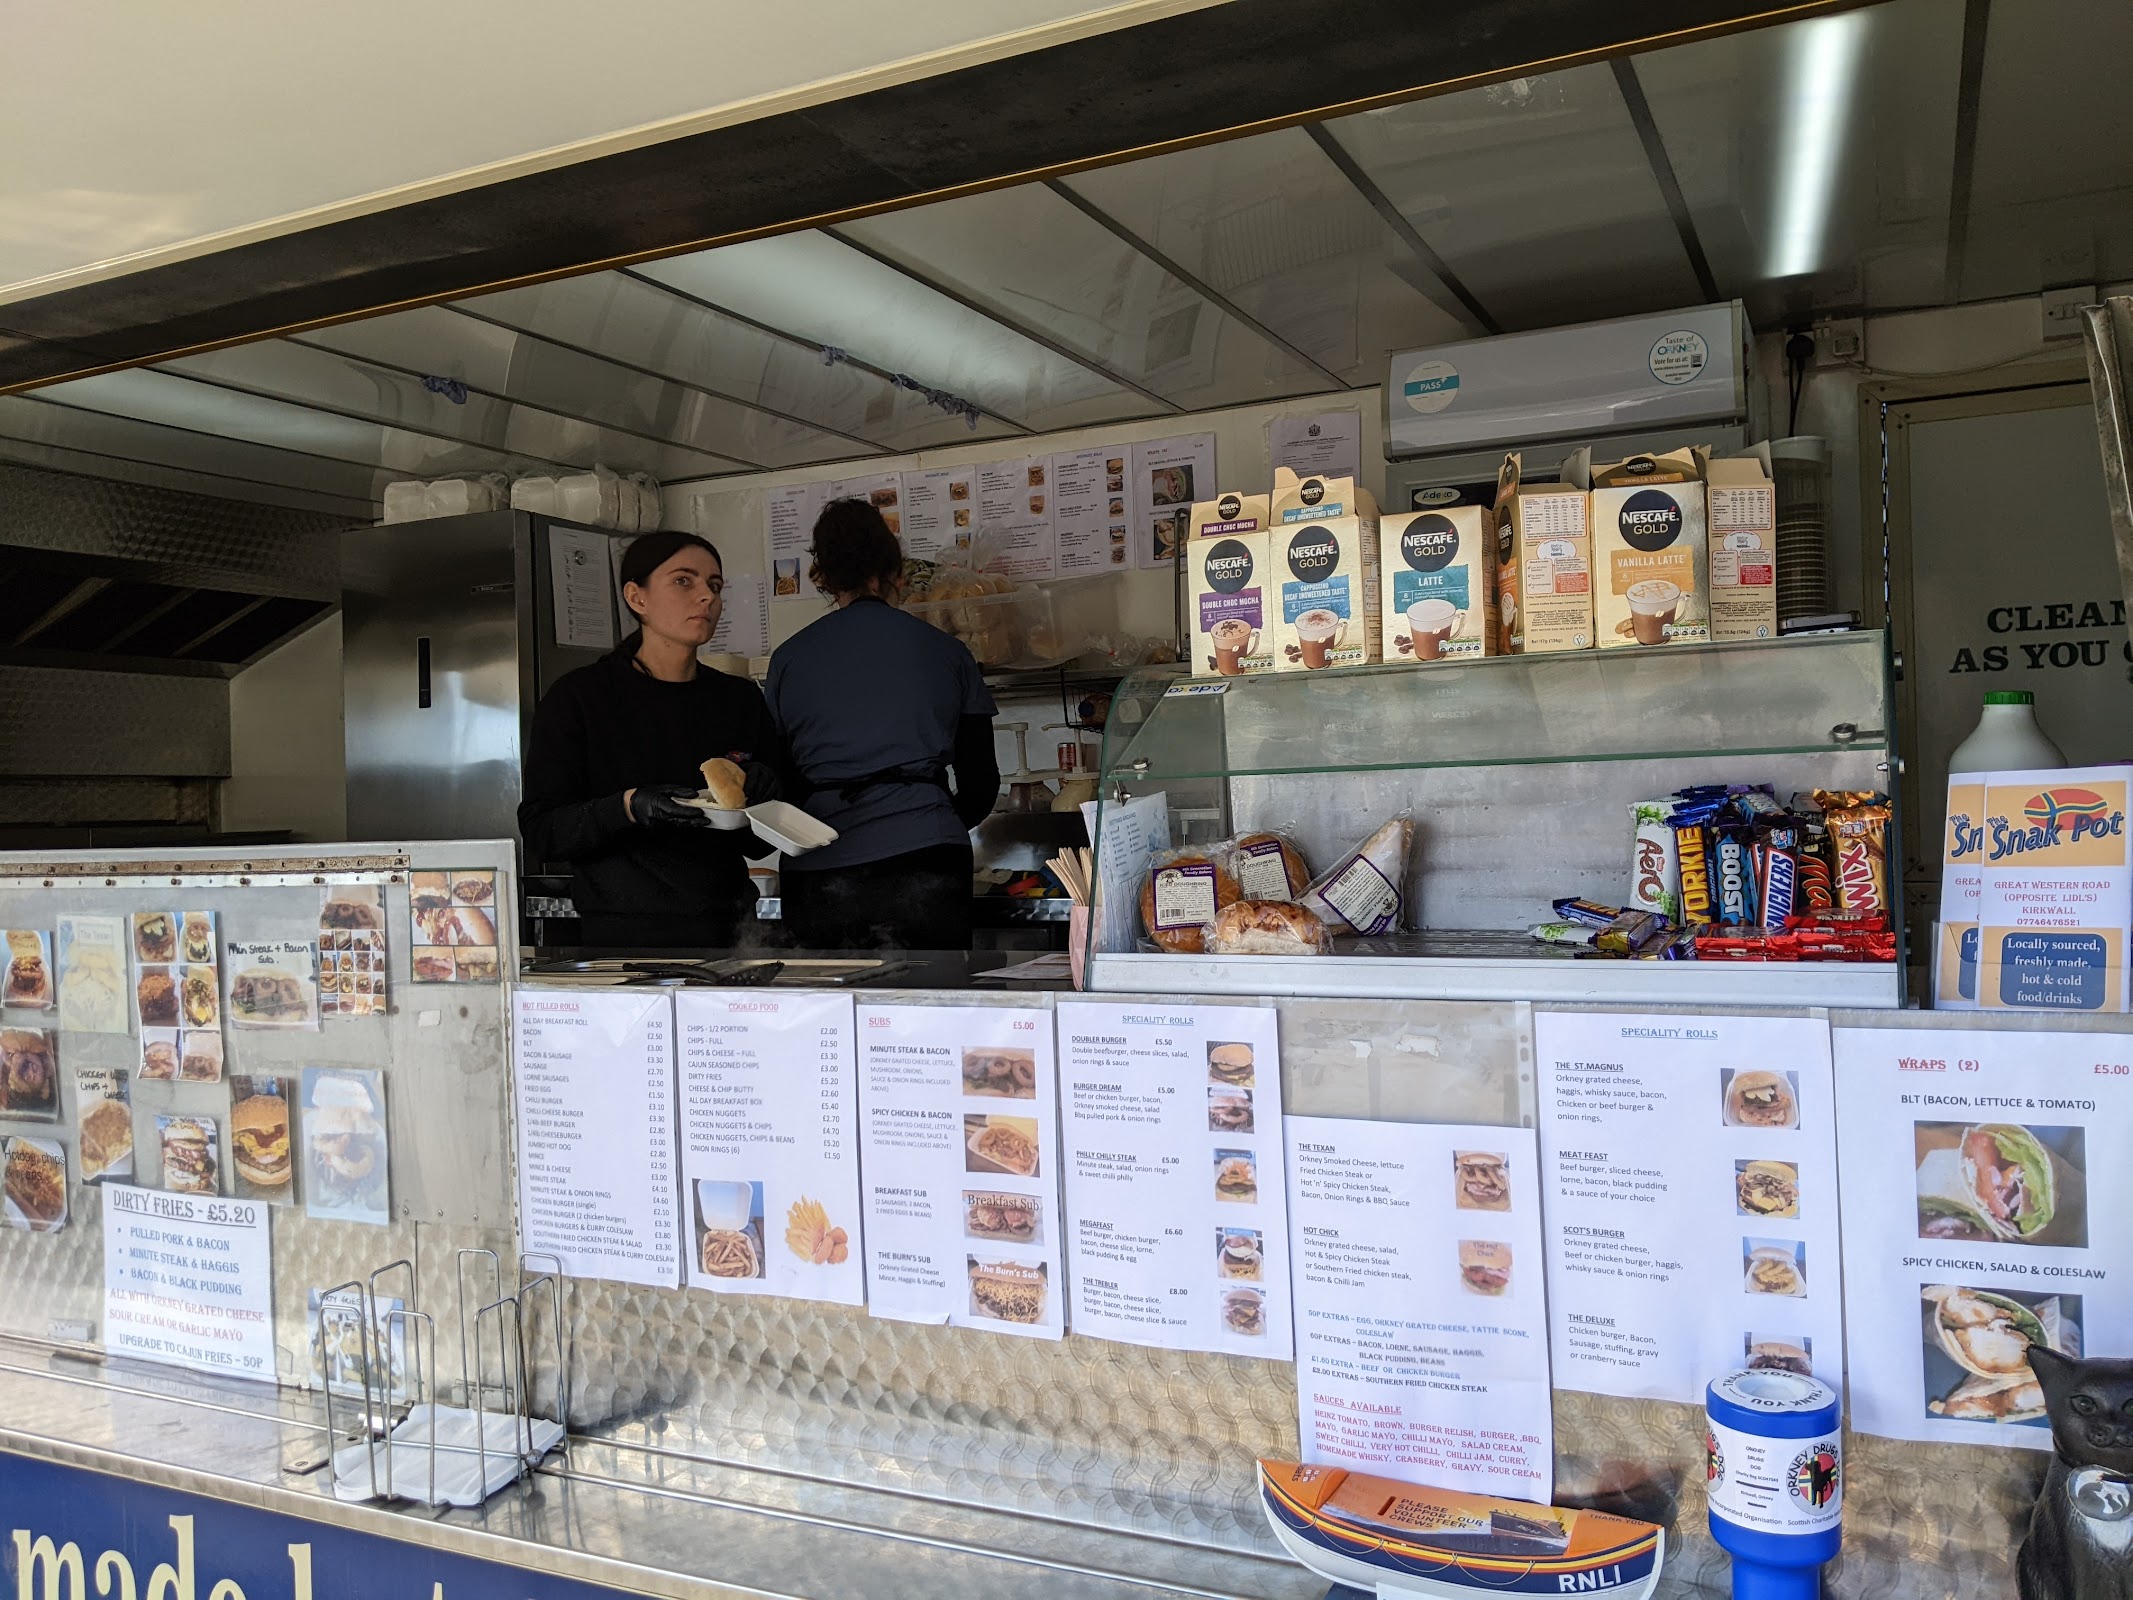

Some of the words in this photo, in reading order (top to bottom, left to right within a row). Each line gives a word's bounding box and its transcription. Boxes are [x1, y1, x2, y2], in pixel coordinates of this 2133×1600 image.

[1657, 342, 1699, 355] ORKNEY
[1420, 380, 1441, 391] PASS
[1203, 524, 1222, 534] DOUBLE
[1223, 523, 1236, 532] CHOC
[1237, 521, 1255, 530] MOCHA
[1633, 523, 1668, 535] GOLD
[1414, 546, 1446, 557] GOLD
[1299, 557, 1329, 568] GOLD
[1617, 556, 1654, 567] VANILLA
[1215, 569, 1242, 579] GOLD
[1300, 582, 1329, 591] CAPPUCCINO
[1418, 576, 1443, 586] LATTE
[1284, 591, 1298, 600] DECAF
[1299, 589, 1329, 600] UNSWEETENED
[1202, 599, 1222, 609] DOUBLE
[1223, 598, 1237, 608] CHOC
[1238, 597, 1259, 607] MOCHA
[1949, 646, 2009, 673] AS
[2020, 640, 2110, 669] YOU
[1987, 814, 2007, 827] The
[1989, 818, 2060, 859] Snak
[2072, 811, 2124, 842] Pot
[1678, 826, 1712, 925] YORKIE
[1721, 843, 1744, 918] BOOST
[1994, 880, 2029, 889] GREAT
[2032, 880, 2081, 889] WESTERN
[2084, 881, 2110, 889] ROAD
[2004, 893, 2057, 902] (OPPOSITE
[2063, 893, 2098, 902] LIDL'S)
[2022, 906, 2076, 915] KIRKWALL
[2017, 918, 2081, 926] 07746476521
[284, 942, 309, 953] Bacon
[2007, 937, 2049, 952] Locally
[2052, 939, 2100, 952] sourced,
[2015, 955, 2052, 970] freshly
[2057, 957, 2091, 969] made,
[2022, 973, 2040, 985] hot
[2044, 975, 2054, 984] &
[2058, 974, 2082, 986] cold
[2017, 990, 2082, 1004] food/drinks
[559, 1002, 580, 1011] ROLLS
[729, 1003, 755, 1012] COOKED
[757, 1003, 779, 1012] FOOD
[869, 1017, 891, 1026] SUBS
[1013, 1021, 1034, 1030] £5.00
[1122, 1015, 1166, 1025] SPECIALITY
[1170, 1017, 1194, 1025] ROLLS
[1621, 1027, 1681, 1038] SPECIALITY
[1686, 1029, 1718, 1038] ROLLS
[1072, 1035, 1098, 1044] DOUBLER
[1100, 1036, 1127, 1045] BURGER
[1155, 1038, 1172, 1046] £5.50
[870, 1046, 896, 1054] MINUTE
[927, 1048, 950, 1056] BACON
[1574, 1062, 1624, 1071] ST.MAGNUS
[1898, 1057, 1946, 1070] WRAPS
[1958, 1059, 1980, 1072] (2)
[2094, 1064, 2130, 1075] £5.00
[80, 1082, 101, 1091] CHIPS
[1901, 1095, 1920, 1104] BLT
[1923, 1095, 1971, 1107] (BACON,
[1975, 1097, 2022, 1107] LETTUCE
[2026, 1099, 2035, 1108] &
[2038, 1099, 2096, 1111] TOMATO)
[822, 1115, 839, 1123] £2.70
[1559, 1151, 1581, 1160] MEAT
[1584, 1152, 1608, 1161] FEAST
[113, 1190, 150, 1212] DIRTY
[154, 1195, 194, 1218] FRIES
[207, 1203, 255, 1224] £5.20
[968, 1194, 1018, 1210] Breakfast
[1020, 1198, 1040, 1211] Sub
[130, 1226, 160, 1242] PULLED
[162, 1231, 184, 1245] PORK
[187, 1236, 193, 1247] &
[197, 1237, 230, 1251] BACON
[129, 1247, 158, 1262] MINUTE
[161, 1252, 188, 1268] STEAK
[192, 1258, 198, 1269] &
[201, 1259, 240, 1273] HAGGIS
[979, 1265, 993, 1273] The
[995, 1266, 1020, 1278] Burn's
[1022, 1269, 1039, 1279] Sub
[1902, 1257, 1932, 1267] SPICY
[1936, 1258, 1987, 1272] CHICKEN,
[1990, 1262, 2027, 1273] SALAD
[2031, 1265, 2040, 1275] &
[2043, 1266, 2106, 1279] COLESLAW
[131, 1268, 158, 1283] BACON
[161, 1274, 167, 1284] &
[169, 1275, 197, 1290] BLACK
[200, 1280, 242, 1295] PUDDING
[110, 1288, 127, 1300] ALL
[128, 1290, 150, 1304] WITH
[151, 1294, 184, 1312] ORKNEY
[186, 1301, 224, 1318] GRATED
[226, 1308, 265, 1323] CHEESE
[109, 1309, 133, 1322] SOUR
[134, 1313, 165, 1329] CREAM
[166, 1319, 178, 1331] OR
[180, 1322, 211, 1338] GARLIC
[213, 1328, 243, 1342] MAYO
[1568, 1314, 1583, 1322] THE
[1585, 1316, 1615, 1325] DELUXE
[119, 1333, 163, 1351] UPGRADE
[164, 1341, 175, 1353] TO
[177, 1344, 203, 1360] CAJUN
[205, 1349, 234, 1364] FRIES
[243, 1354, 263, 1368] 50P
[1723, 1370, 1753, 1387] THANK
[1313, 1394, 1344, 1407] SAUCES
[1351, 1401, 1402, 1415] AVAILABLE
[1788, 1450, 1808, 1497] ORKNEY
[1401, 1499, 1449, 1514] PLEASE
[1389, 1514, 1433, 1528] CREWS
[1394, 1509, 1467, 1530] VOLUNTEER
[1397, 1504, 1454, 1521] SUPPORT
[1457, 1515, 1484, 1527] OUR
[1590, 1513, 1617, 1522] THANK
[1622, 1518, 1645, 1526] YOU
[1743, 1511, 1783, 1525] Organisation
[1812, 1515, 1834, 1525] Charitable
[1558, 1564, 1622, 1592] RNLI
